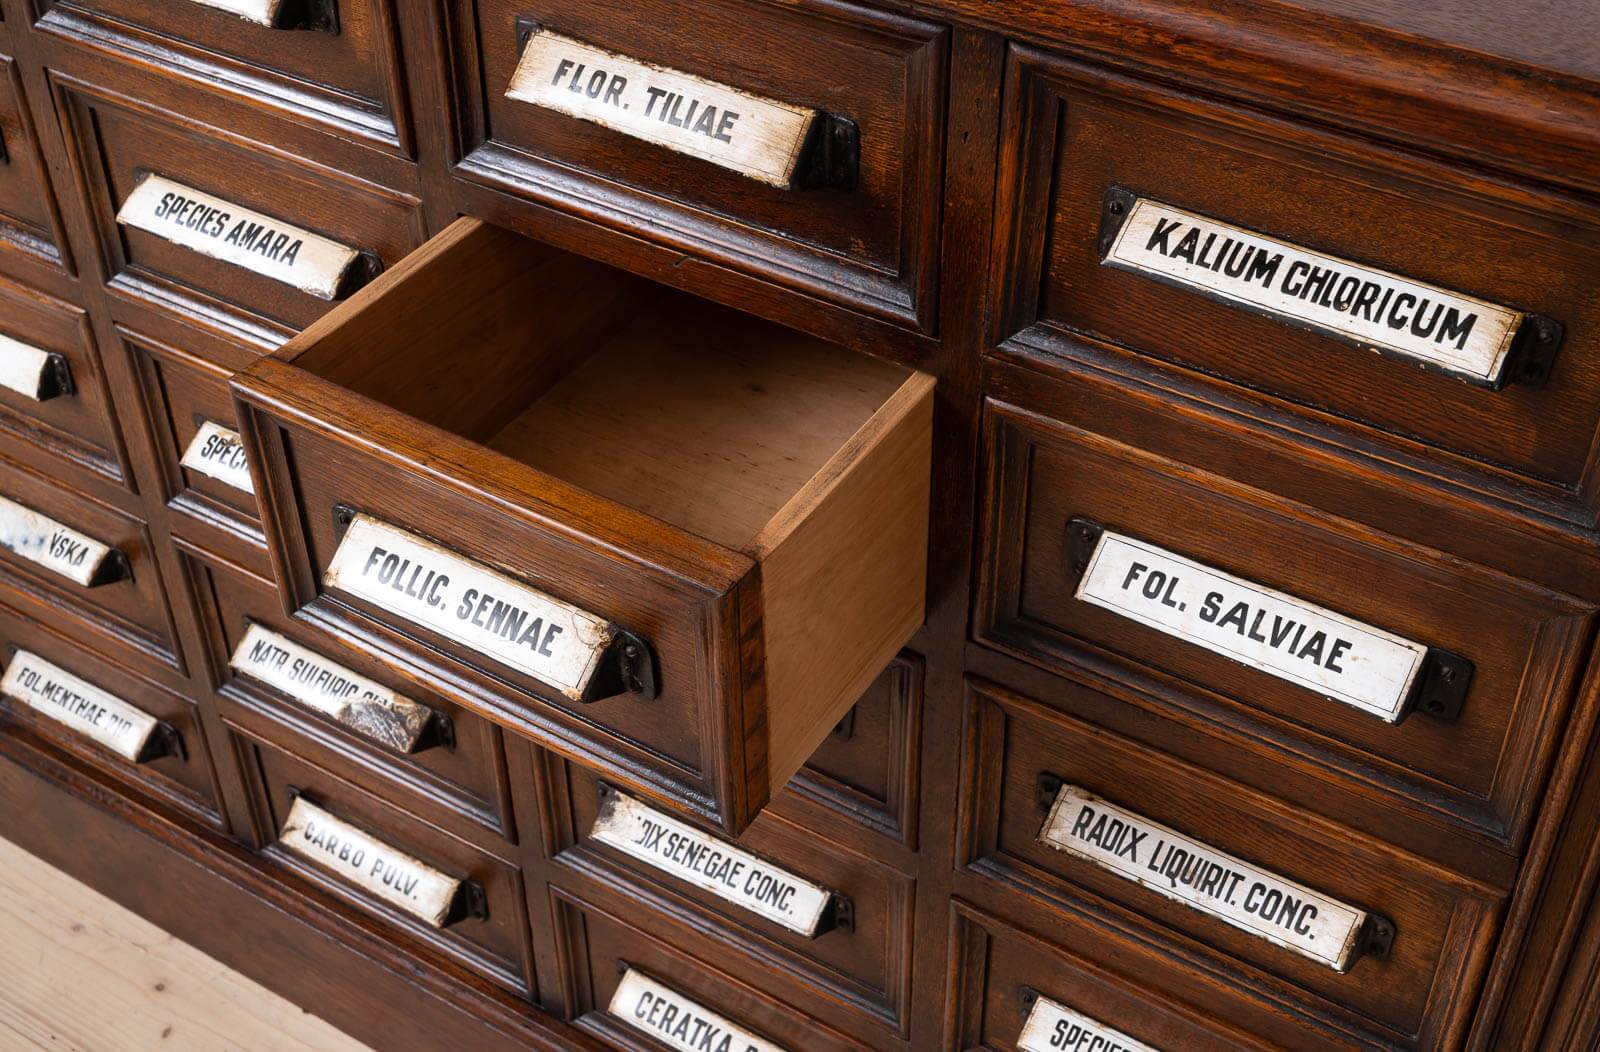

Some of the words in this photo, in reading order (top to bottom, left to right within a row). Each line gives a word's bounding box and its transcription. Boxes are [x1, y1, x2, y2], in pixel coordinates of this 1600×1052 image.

[551, 58, 629, 110] FLOR.
[643, 86, 740, 145] TILIAE
[154, 192, 231, 238] SPECIES
[224, 219, 303, 266] AMARA
[1145, 216, 1284, 289] KALIUM
[1280, 260, 1478, 351] CHLORICUM
[361, 545, 450, 611] FOLLIC.
[455, 587, 564, 659] SENNAE
[1121, 560, 1187, 613] FOL.
[1198, 591, 1353, 675] SALVIAE
[40, 679, 107, 726] MENTHAE
[303, 821, 366, 868] CARBO
[370, 858, 419, 900] PULV.
[663, 832, 745, 888] SENEGAE
[743, 869, 797, 915] CONC.
[1070, 805, 1149, 864] RADIX
[1146, 839, 1246, 907] LIQUIRIT.
[1243, 881, 1320, 941] CONC.
[634, 991, 733, 1052] CERATKA
